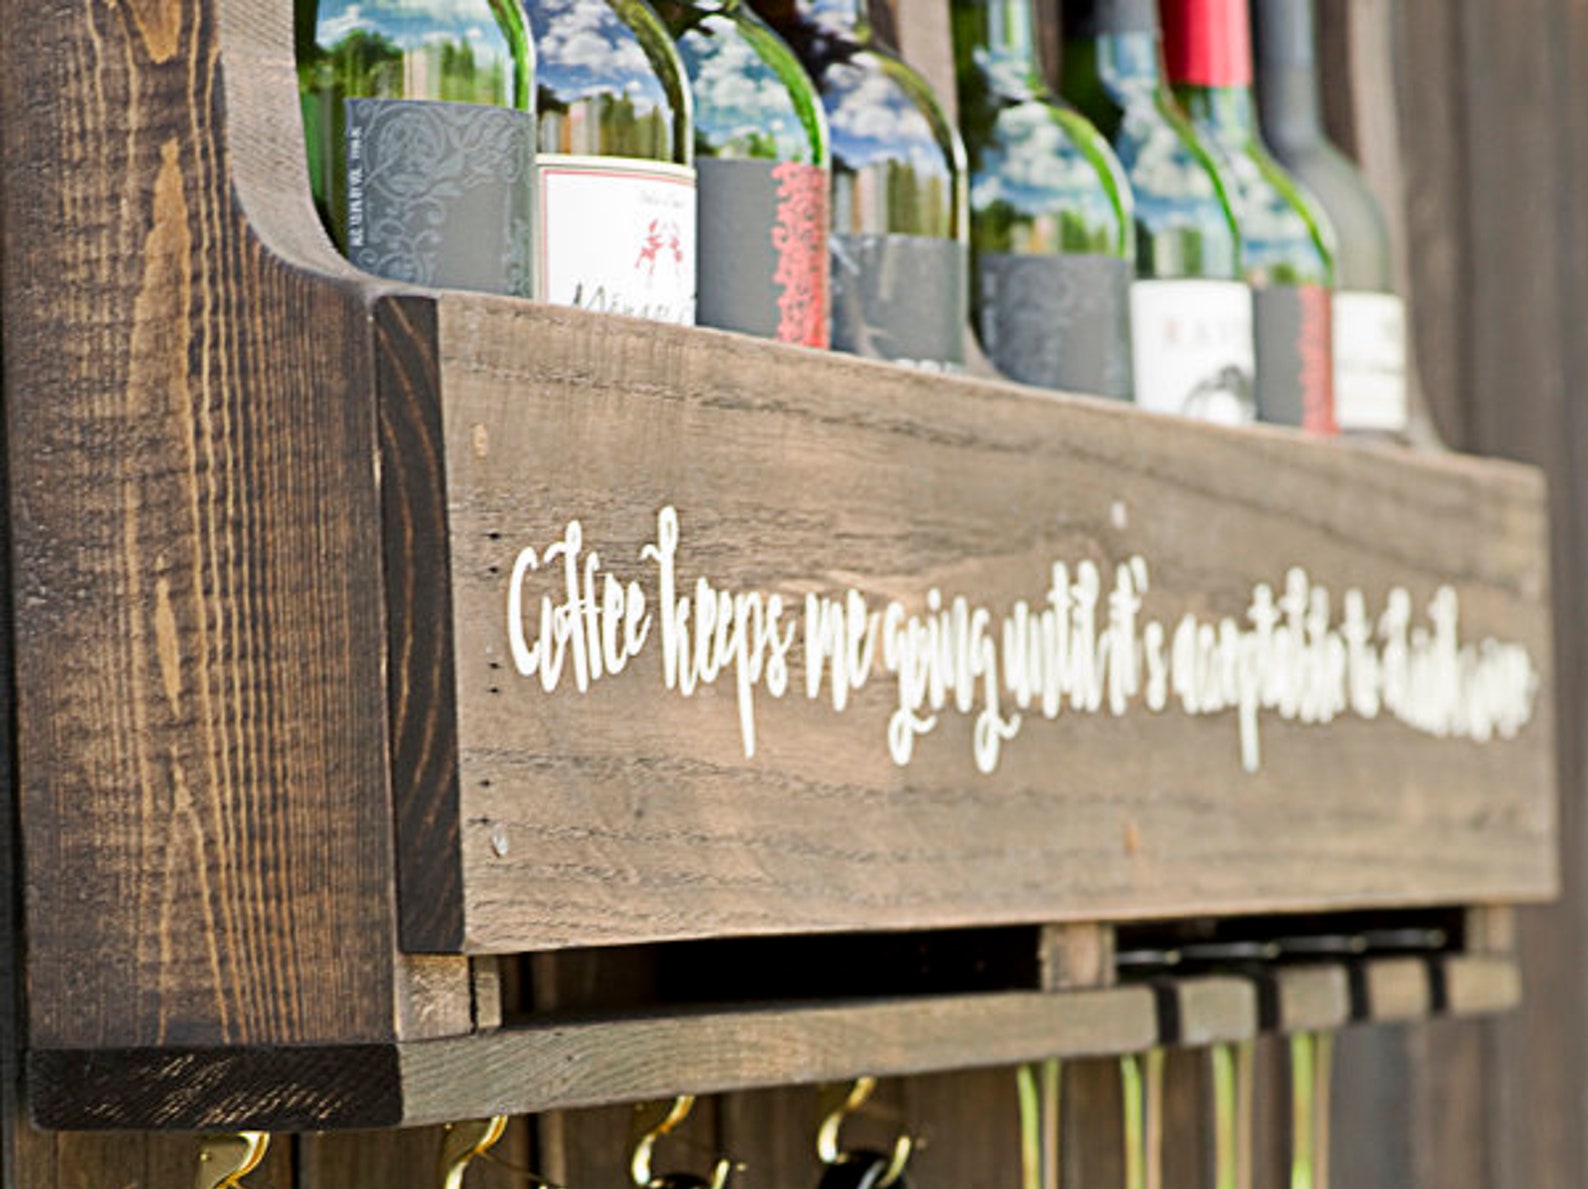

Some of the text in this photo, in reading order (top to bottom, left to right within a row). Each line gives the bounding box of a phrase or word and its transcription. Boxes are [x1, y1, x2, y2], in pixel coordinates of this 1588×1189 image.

[507, 519, 651, 693] Coffee
[641, 505, 796, 758] keeps
[805, 588, 881, 712] me
[882, 588, 1023, 773] going
[1002, 560, 1101, 719] until
